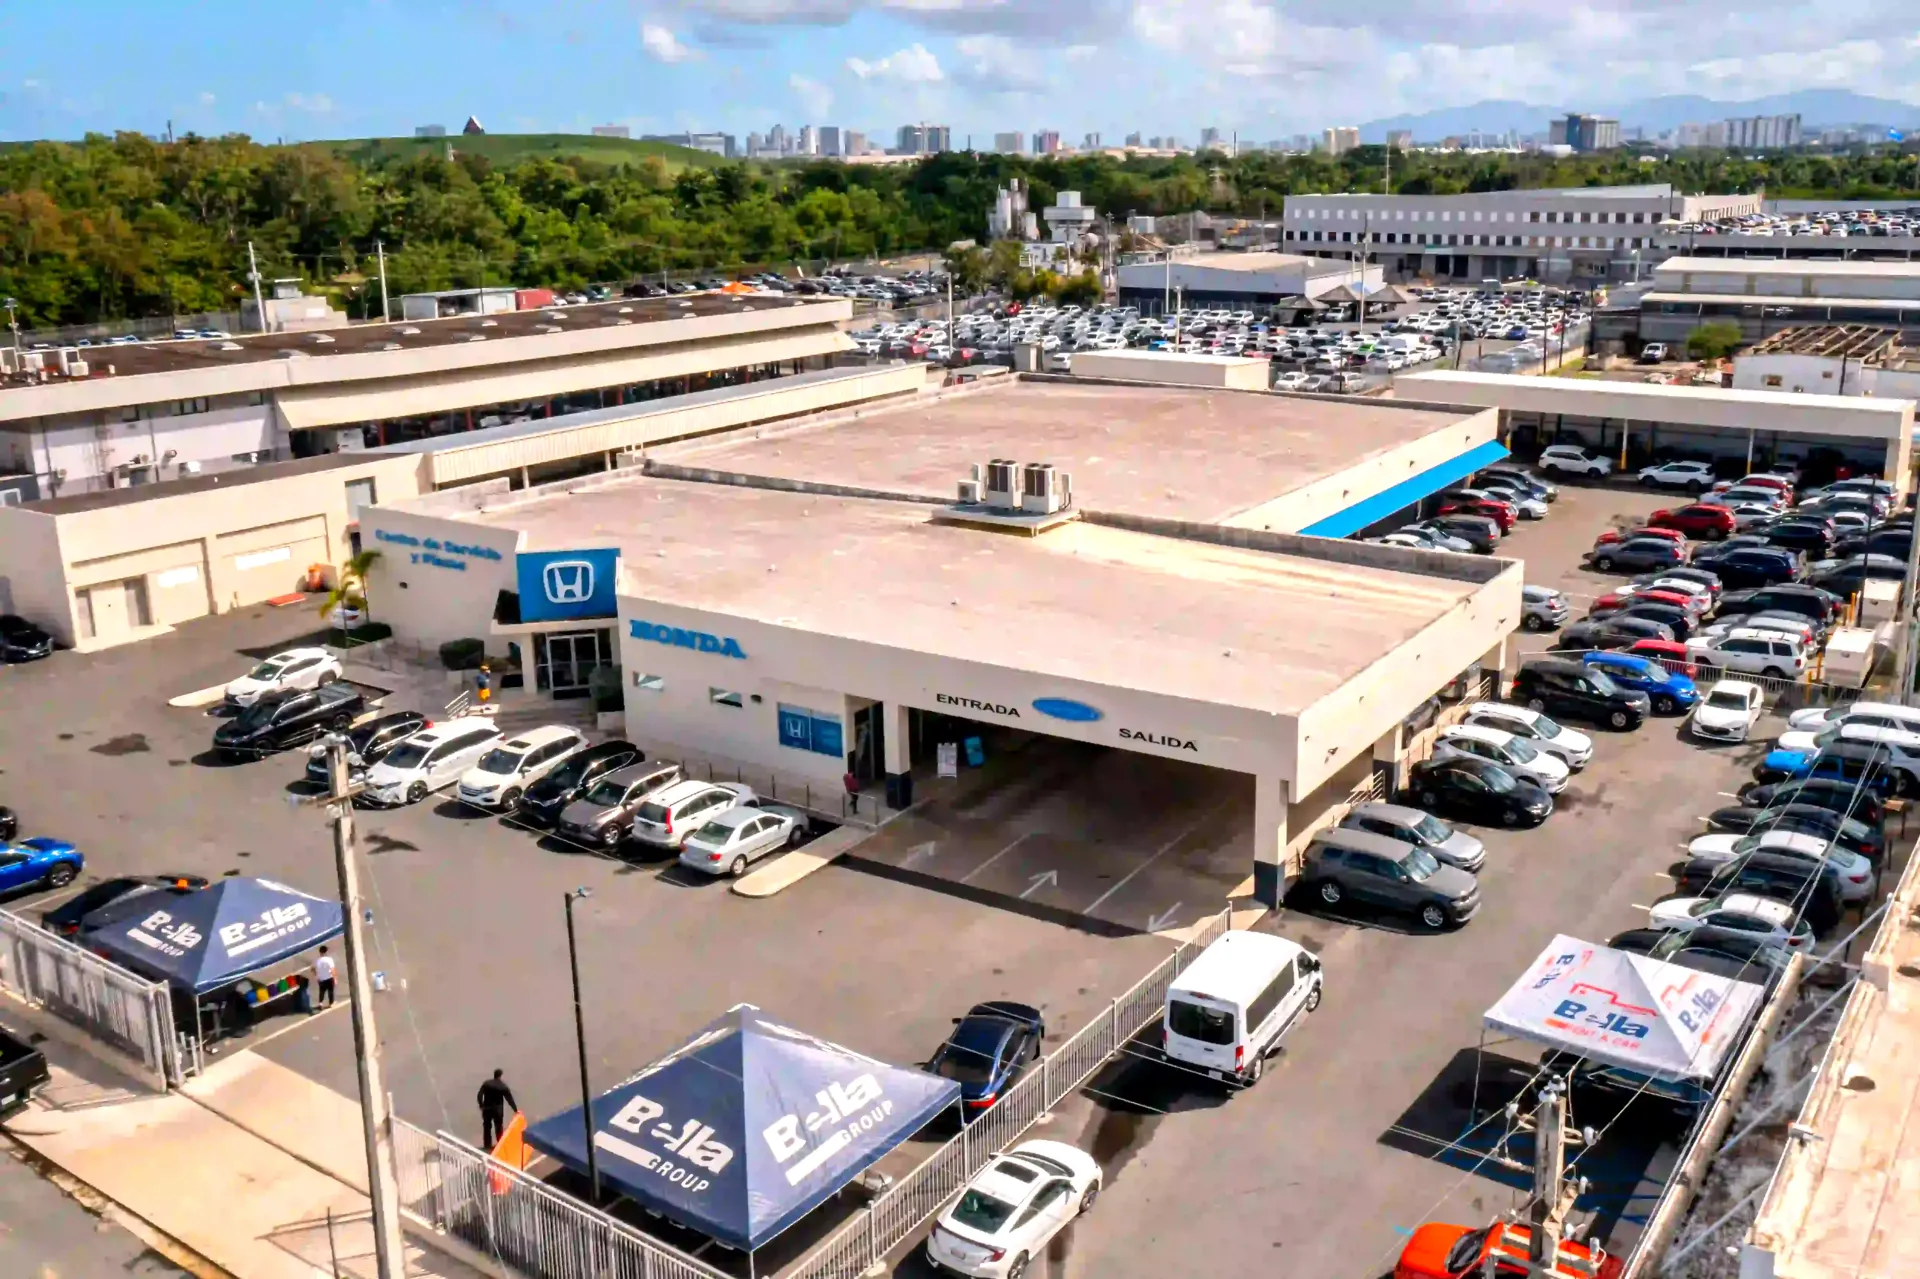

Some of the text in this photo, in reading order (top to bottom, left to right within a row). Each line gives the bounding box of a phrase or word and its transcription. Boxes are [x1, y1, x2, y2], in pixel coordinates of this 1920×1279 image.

[630, 619, 748, 660] HONDA
[936, 693, 1021, 718] ENTRADA
[1119, 727, 1198, 752] SALIDA
[609, 1095, 733, 1174] Bella
[763, 1073, 883, 1163] Bella
[842, 1100, 893, 1142] GROUP
[647, 1158, 709, 1192] GROUP
